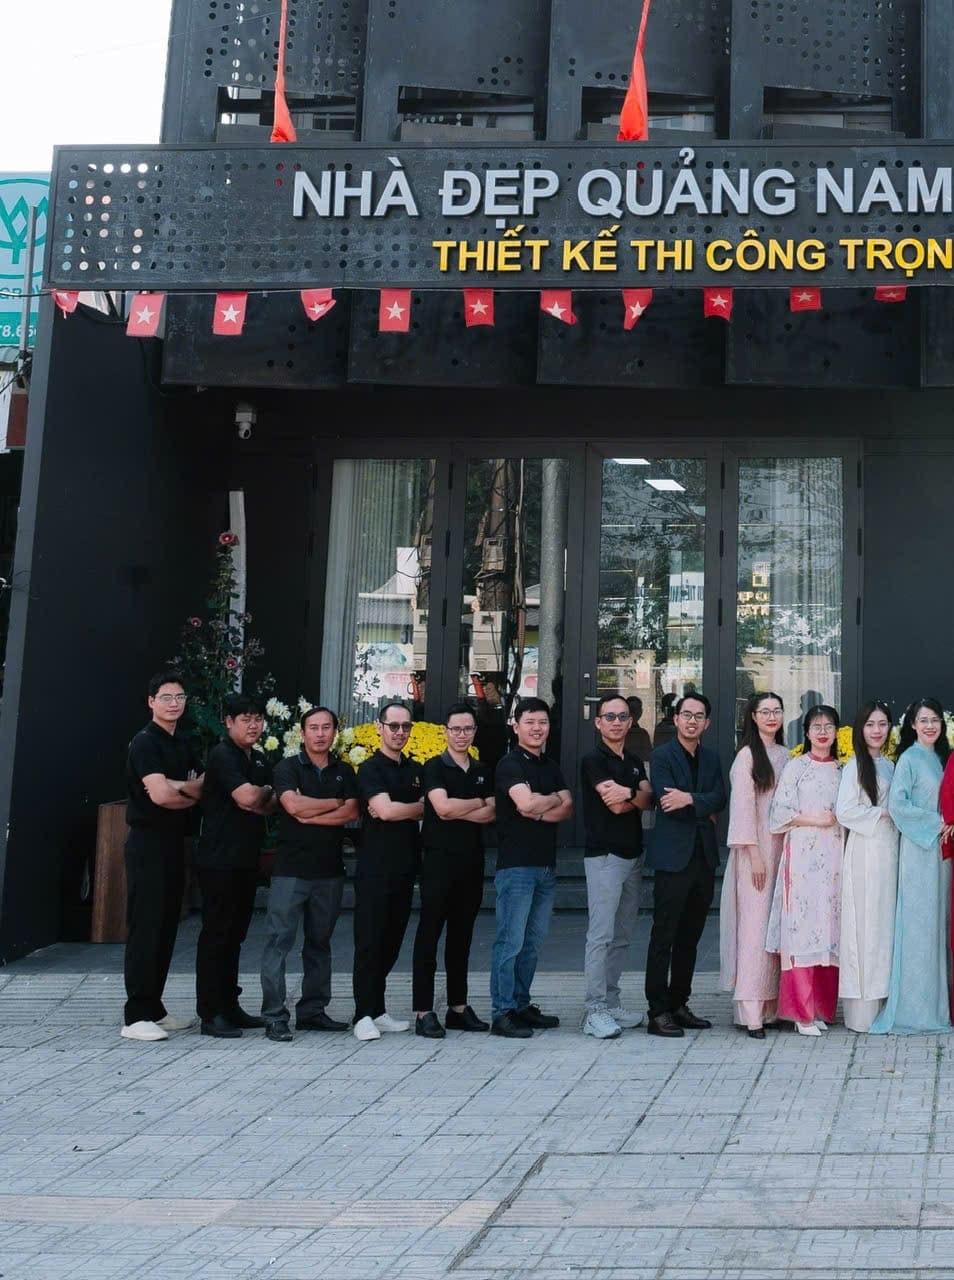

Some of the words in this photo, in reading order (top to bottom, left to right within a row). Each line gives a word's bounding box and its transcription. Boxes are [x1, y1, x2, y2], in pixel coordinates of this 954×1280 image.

[293, 157, 419, 217] NHÀ
[438, 170, 560, 229] ĐẸP
[577, 147, 796, 219] QUẢNG
[816, 167, 953, 214] NAM
[432, 224, 550, 271] THIẾT
[562, 225, 622, 271] KẾ
[630, 239, 693, 271] THI
[706, 229, 826, 272] CÔNG
[839, 238, 953, 277] TRỌN
